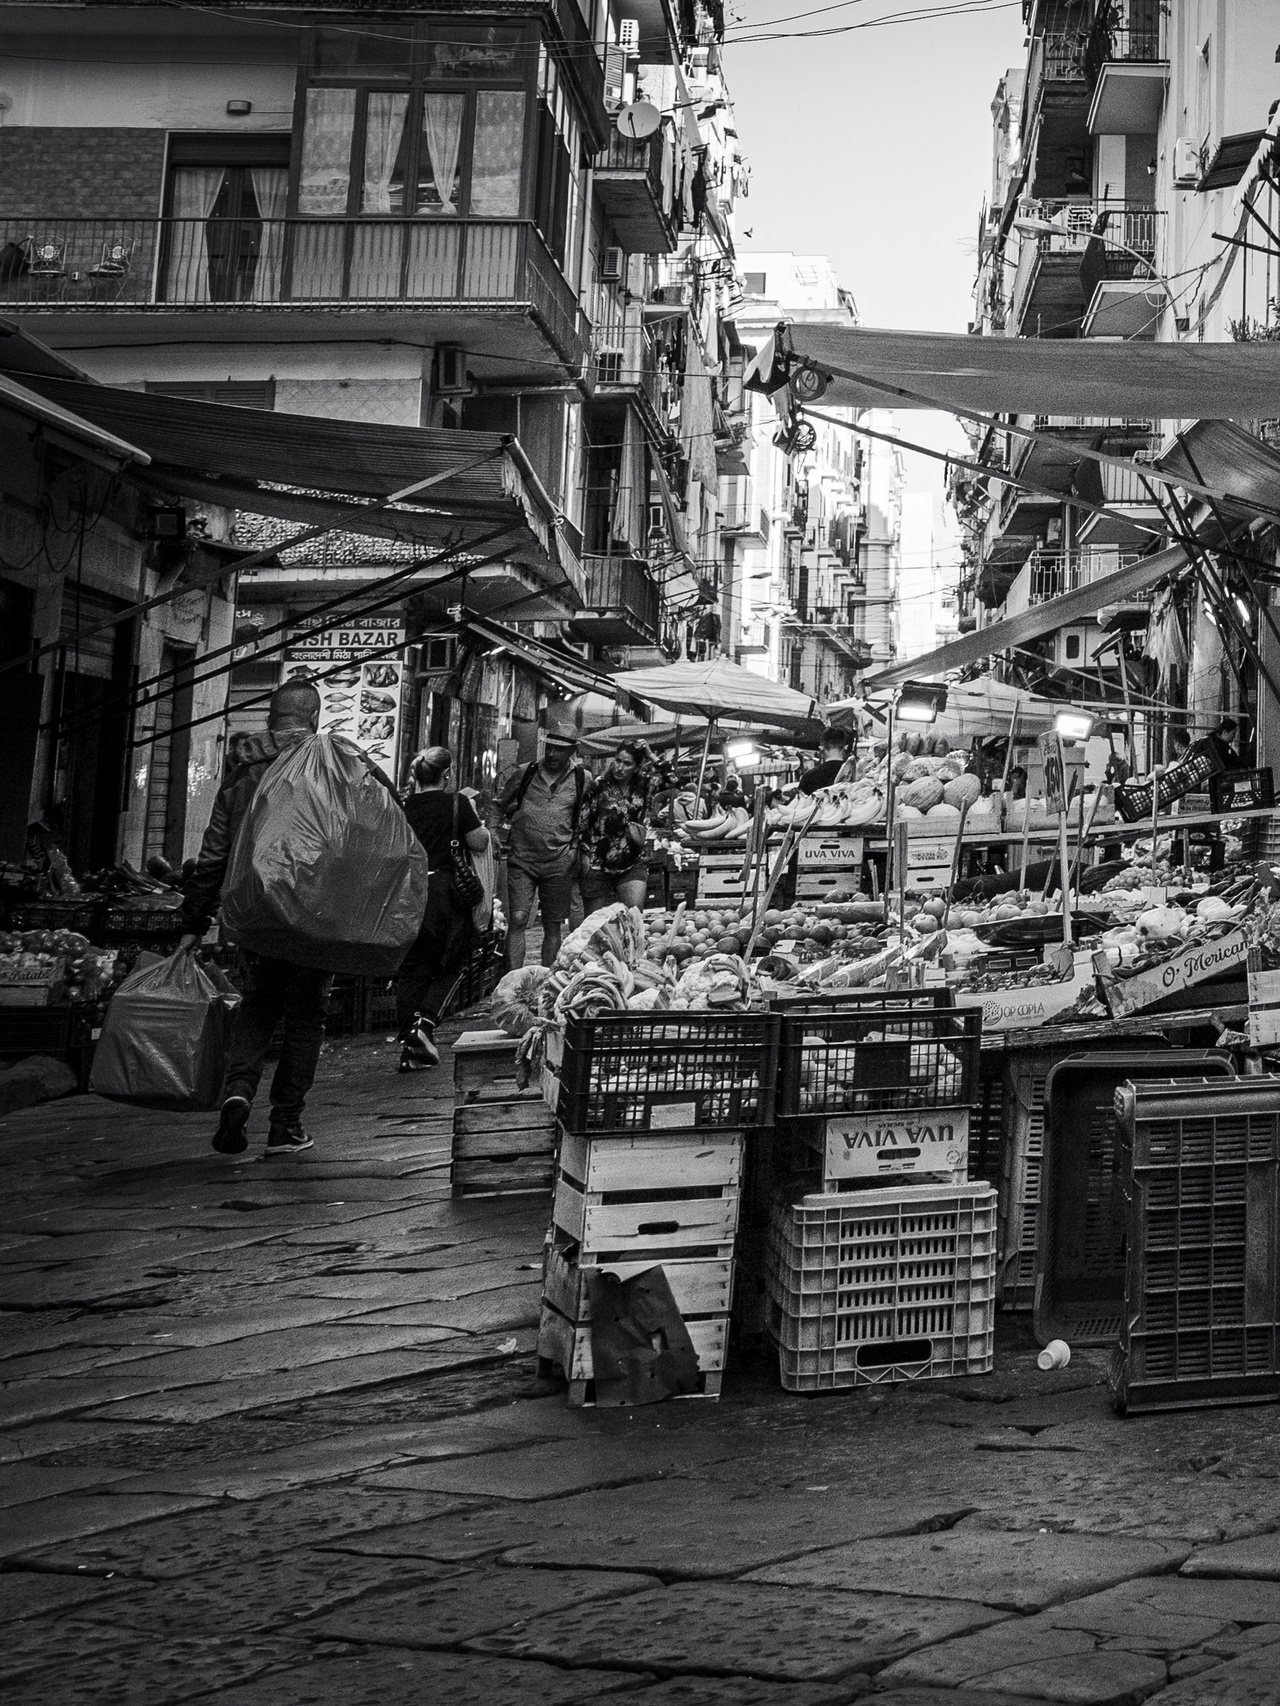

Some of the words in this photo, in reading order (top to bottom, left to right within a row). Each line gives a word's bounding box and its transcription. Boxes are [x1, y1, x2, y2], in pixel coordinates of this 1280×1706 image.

[293, 632, 332, 647] FISH
[338, 632, 398, 647] BAZAR
[805, 850, 827, 858] UVA
[831, 849, 856, 858] VIVA
[842, 1129, 898, 1149] VIVA
[905, 1125, 954, 1144] UVA
